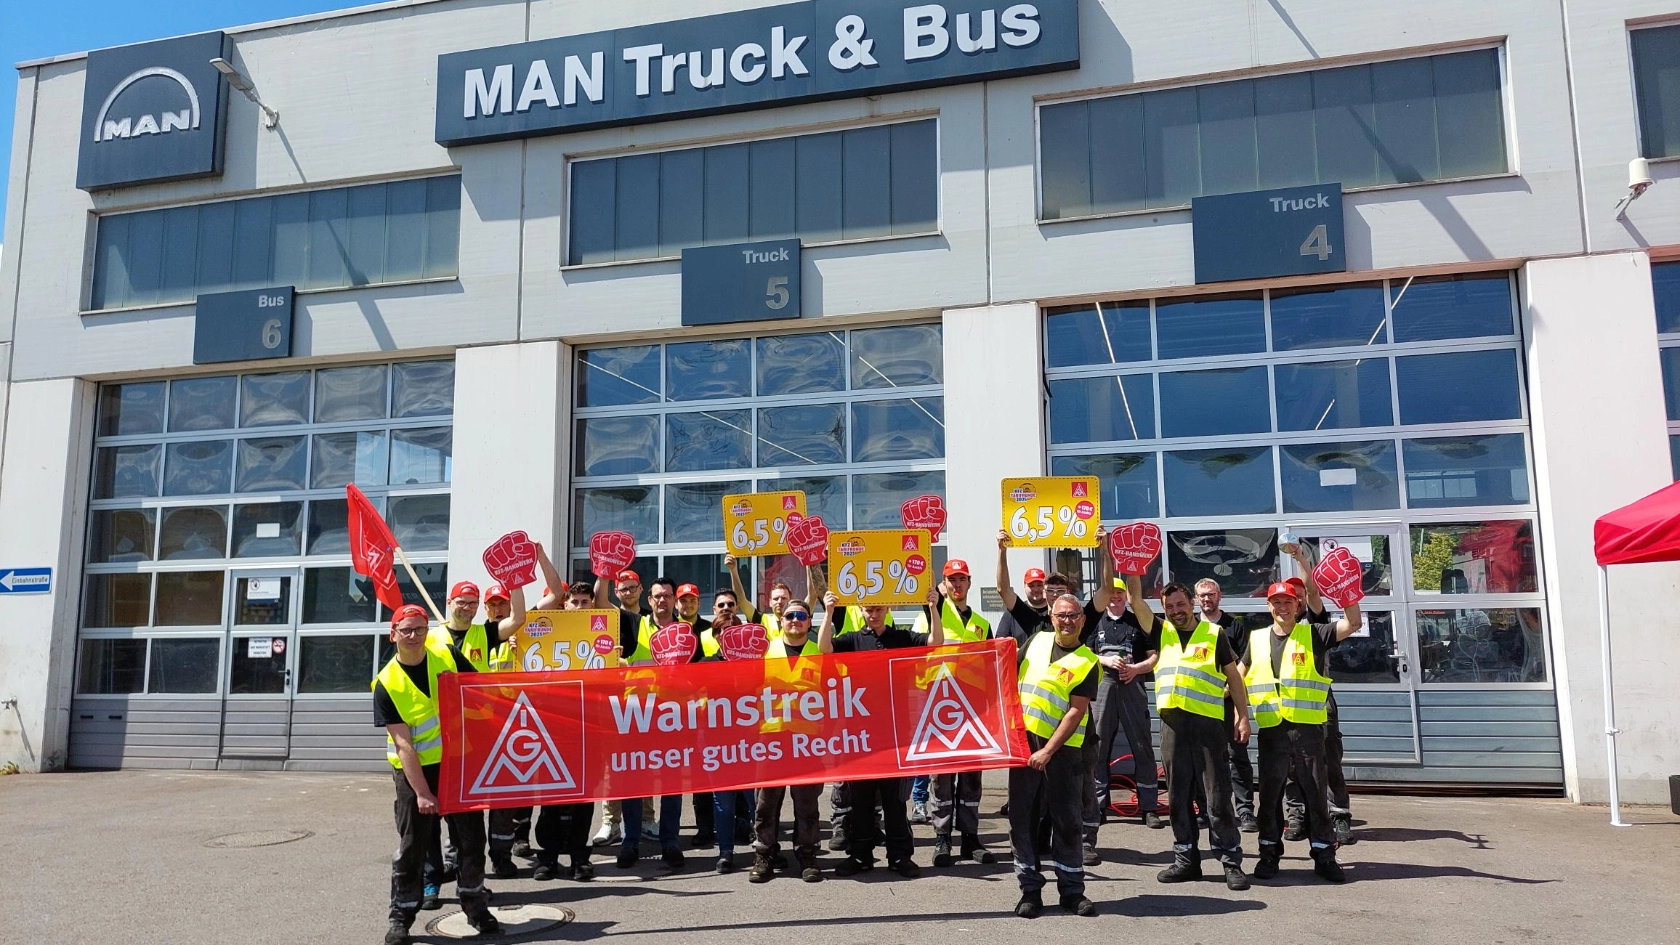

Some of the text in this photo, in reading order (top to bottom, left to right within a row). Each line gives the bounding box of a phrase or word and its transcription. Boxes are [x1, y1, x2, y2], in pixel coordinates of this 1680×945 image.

[463, 4, 1040, 118] MAN Truck & Bus
[103, 109, 190, 140] MAN
[1269, 193, 1330, 212] Truck
[742, 247, 790, 264] Truck
[1300, 224, 1332, 261] 4
[259, 295, 284, 308] Bus
[765, 276, 790, 309] 5
[262, 319, 281, 349] 6
[732, 518, 770, 553] 6,5
[1011, 505, 1087, 542] 6,5 %
[494, 557, 534, 576] KFZ-HANDWERK
[838, 559, 918, 600] 6,5 %
[608, 676, 871, 735] Warnstreik
[611, 728, 871, 772] unser gutes Recht
